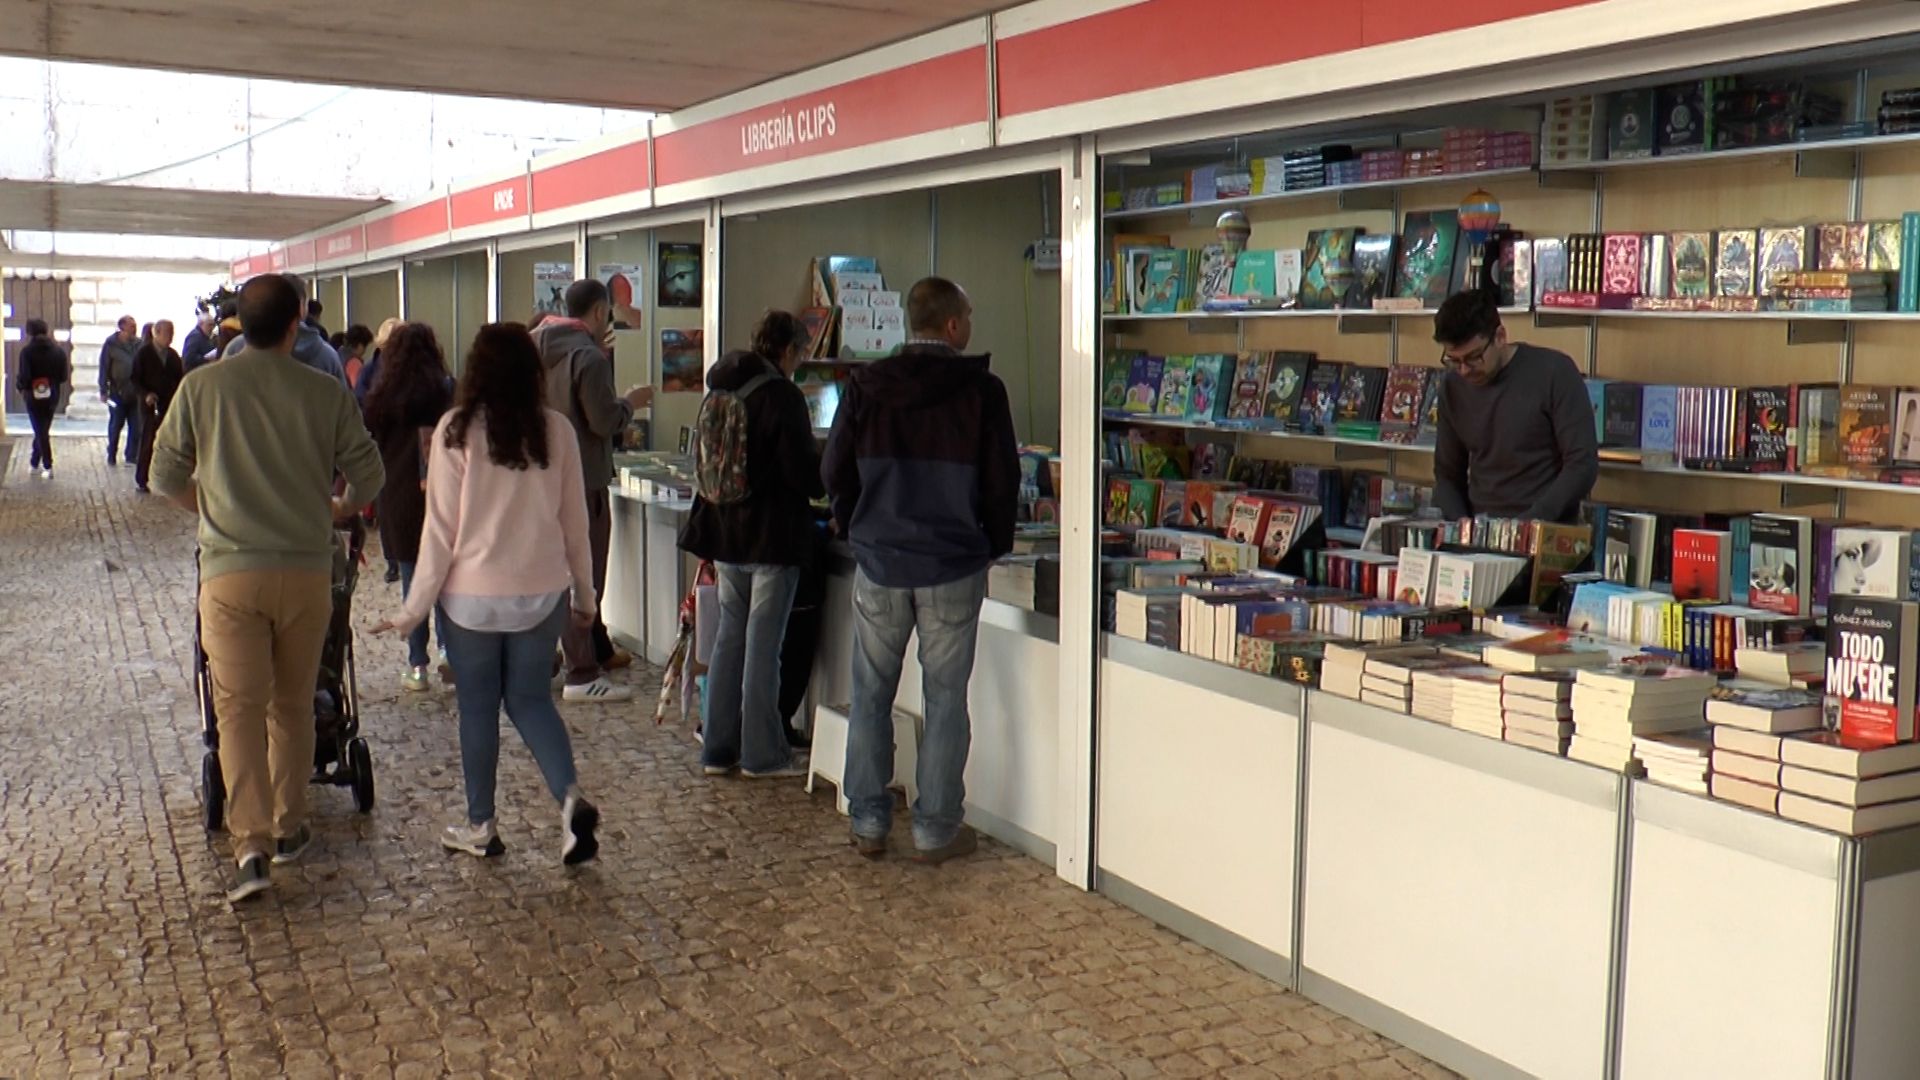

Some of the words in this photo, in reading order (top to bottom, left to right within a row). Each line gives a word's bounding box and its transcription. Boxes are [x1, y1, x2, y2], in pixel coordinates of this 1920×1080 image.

[741, 107, 795, 155] LIBRERÍA
[797, 102, 836, 144] CLIPS
[1840, 631, 1884, 662] TODO
[1826, 657, 1896, 704] MUERE
